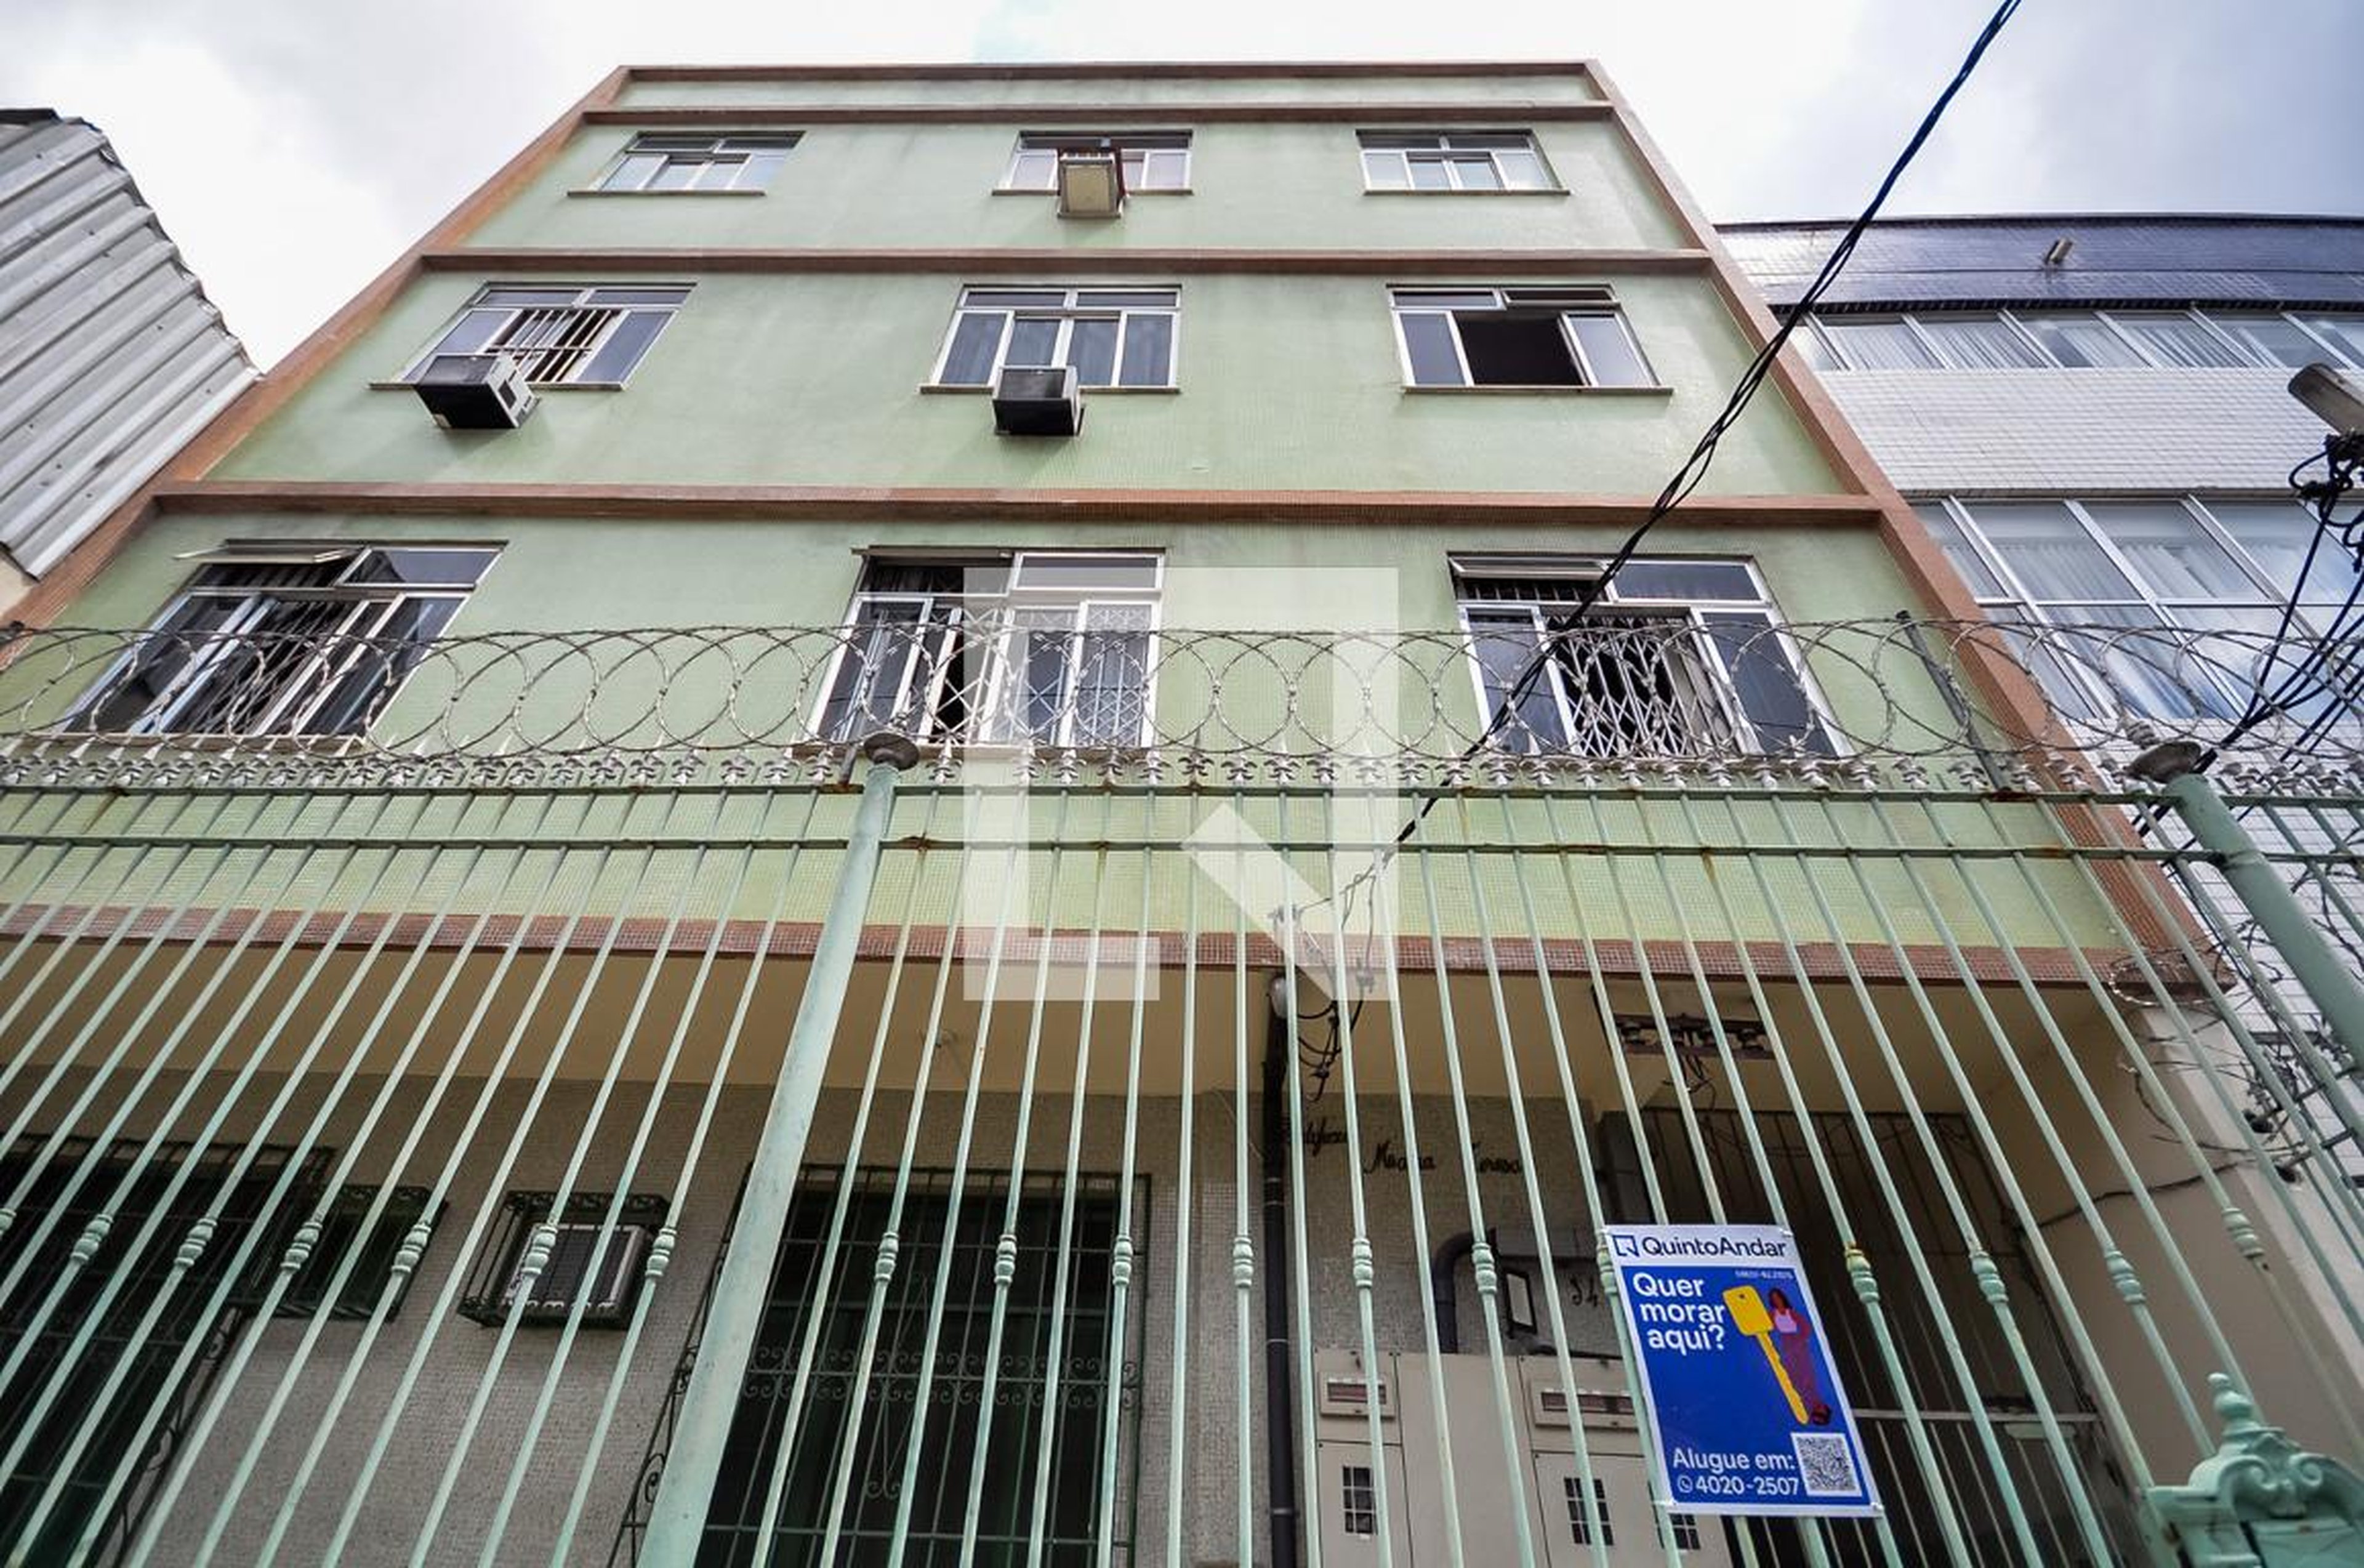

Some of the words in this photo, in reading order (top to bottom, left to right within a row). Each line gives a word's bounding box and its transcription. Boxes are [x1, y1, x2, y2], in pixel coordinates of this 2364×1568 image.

[1642, 1236, 1787, 1256] QuintoAndar
[1633, 1272, 1705, 1297] Quer
[1640, 1303, 1725, 1324] morar
[1647, 1324, 1724, 1356] aqui?
[1673, 1447, 1750, 1474] Alugue
[1755, 1453, 1796, 1470] em:
[1695, 1475, 1799, 1495] 4020-2507
